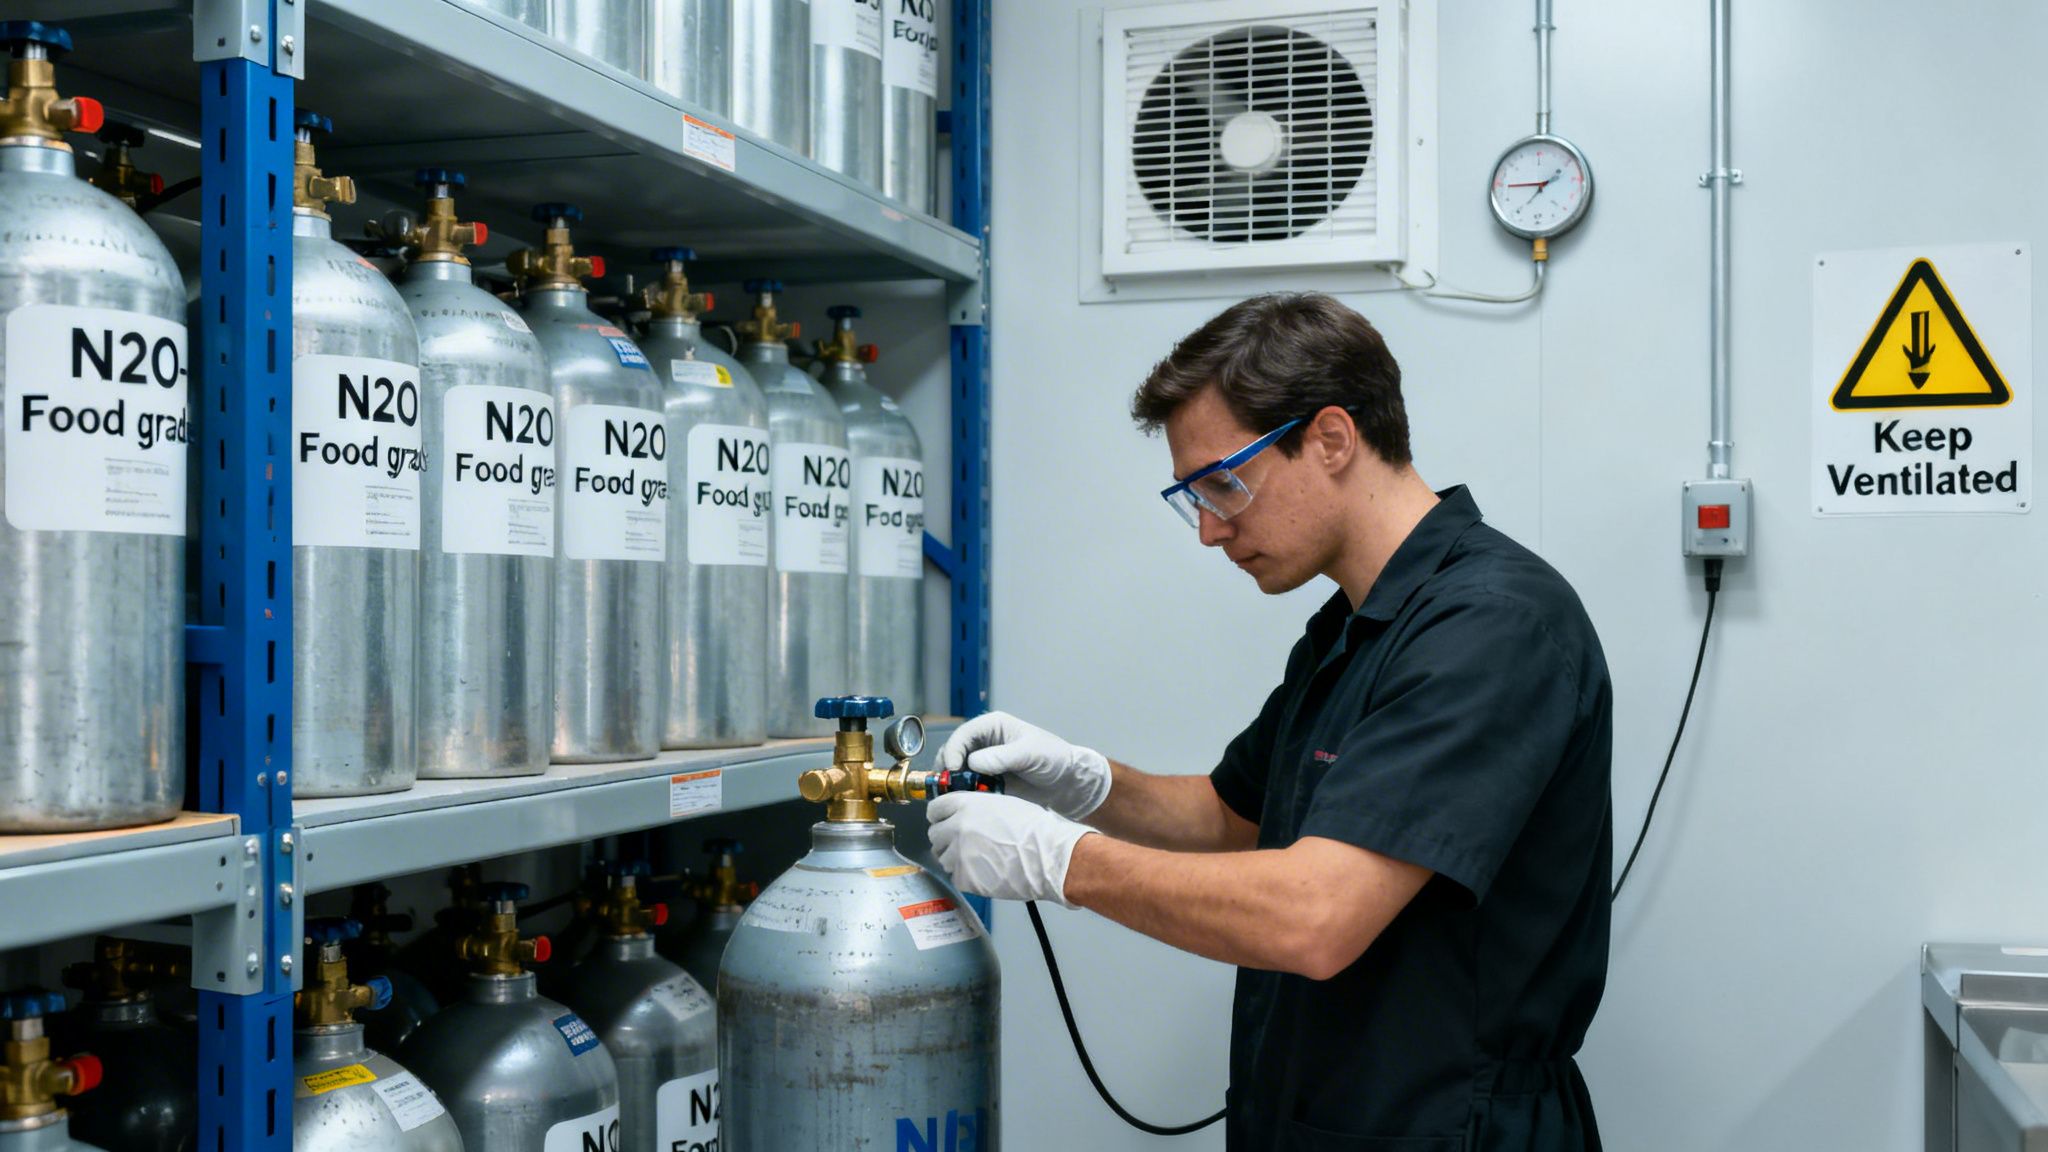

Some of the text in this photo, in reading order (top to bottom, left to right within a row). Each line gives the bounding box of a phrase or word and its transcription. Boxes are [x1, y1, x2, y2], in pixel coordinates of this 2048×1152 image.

[22, 394, 124, 436] Food
[300, 432, 378, 467] Food
[1874, 420, 1972, 460] Keep
[456, 453, 523, 483] Food
[575, 466, 634, 495] Food
[1827, 460, 2018, 496] Ventilated
[698, 482, 749, 508] Food
